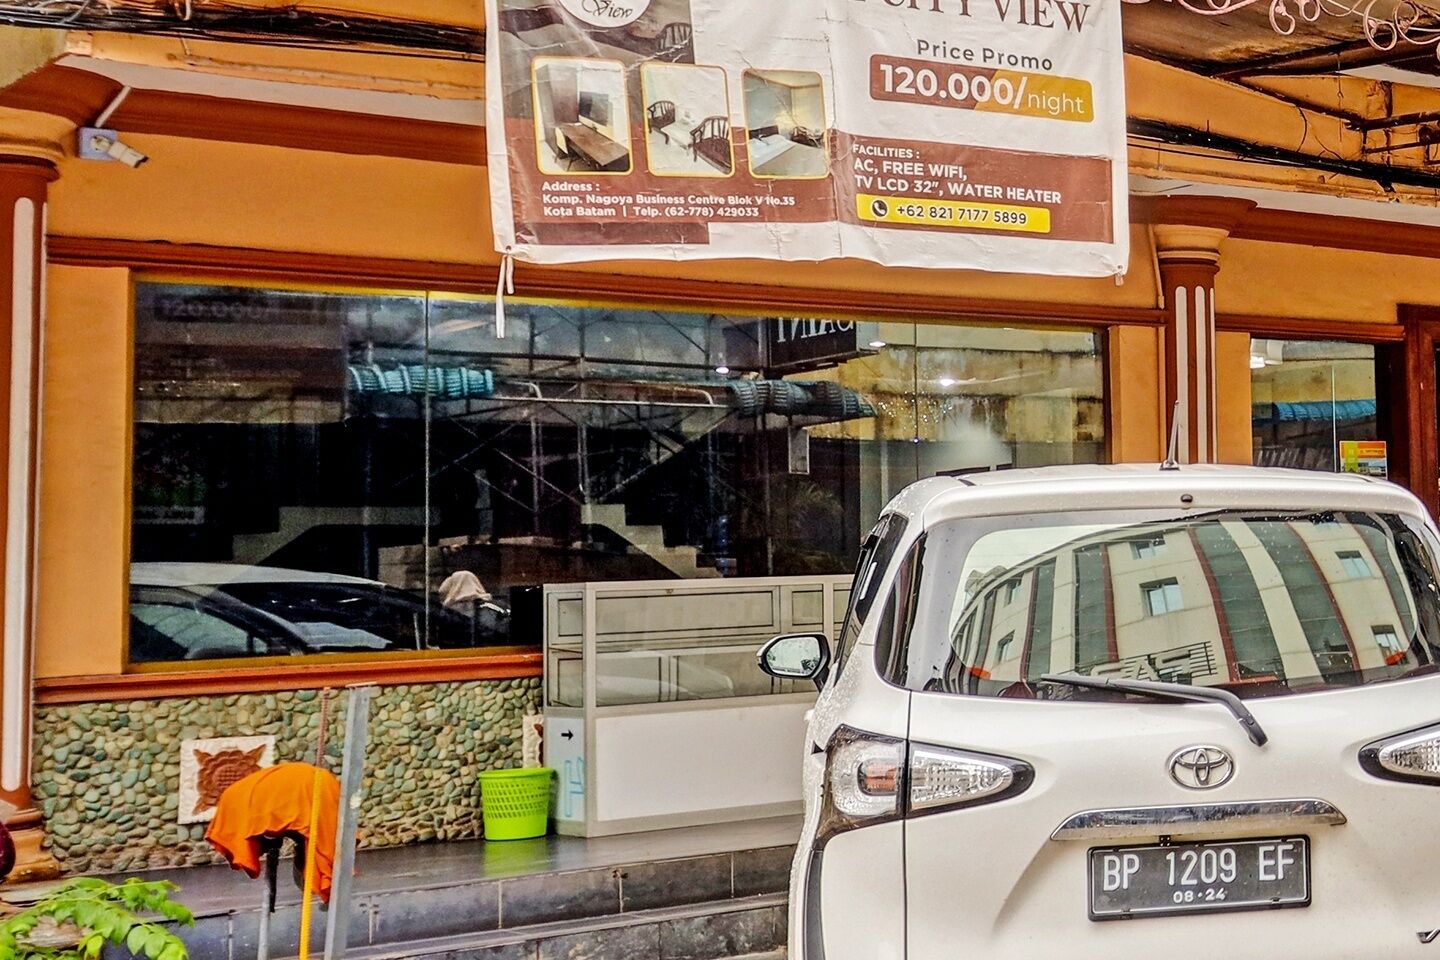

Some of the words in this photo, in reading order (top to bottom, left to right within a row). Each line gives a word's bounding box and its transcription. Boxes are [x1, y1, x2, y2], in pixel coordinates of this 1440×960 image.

[917, 40, 975, 61] Price
[982, 48, 1053, 71] Promo
[854, 160, 879, 174] AC,
[882, 161, 924, 176] FREE
[928, 164, 968, 181] WIFI,
[542, 181, 592, 191] Address
[854, 175, 873, 189] TV
[877, 177, 909, 192] LCD
[948, 182, 1003, 200] WATER
[1006, 187, 1062, 205] HEATER
[542, 194, 583, 205] Komp.
[586, 194, 633, 205] Nagoya
[636, 194, 685, 204] Business
[688, 195, 726, 205] Centre
[728, 195, 752, 205] Blok
[543, 206, 573, 216] Kota
[576, 206, 616, 216] Batam
[633, 207, 662, 217] Telp.
[665, 207, 714, 218] (62-778)
[717, 207, 760, 217] 429033
[897, 205, 924, 218] +62
[929, 207, 953, 220] 821
[958, 209, 989, 222] 7177
[994, 211, 1027, 225] 5899
[1103, 854, 1140, 891] BP
[1165, 848, 1237, 886] 1209
[1258, 844, 1295, 881] EF
